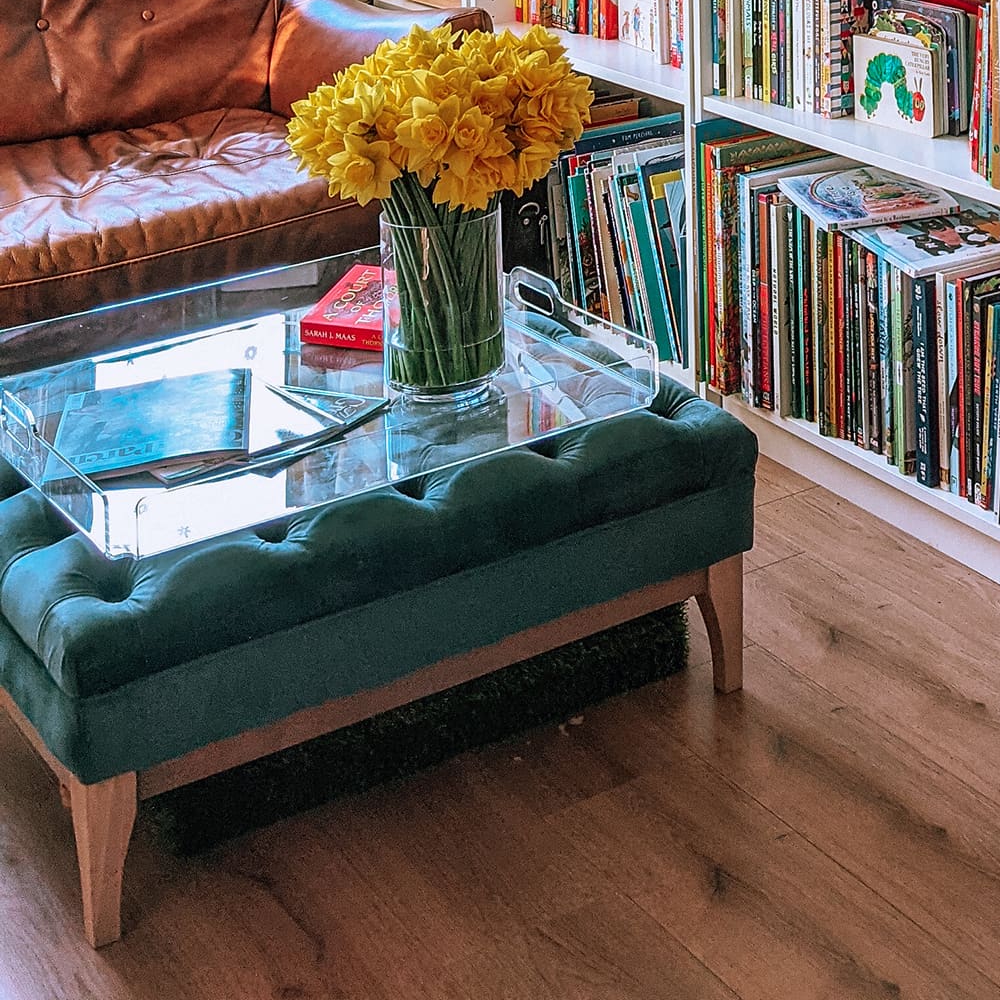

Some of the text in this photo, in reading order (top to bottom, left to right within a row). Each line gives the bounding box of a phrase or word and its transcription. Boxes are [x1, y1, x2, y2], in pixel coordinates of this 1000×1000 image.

[333, 270, 379, 310] COURT
[351, 297, 367, 313] OF
[304, 329, 356, 341] SARAH MAAS
